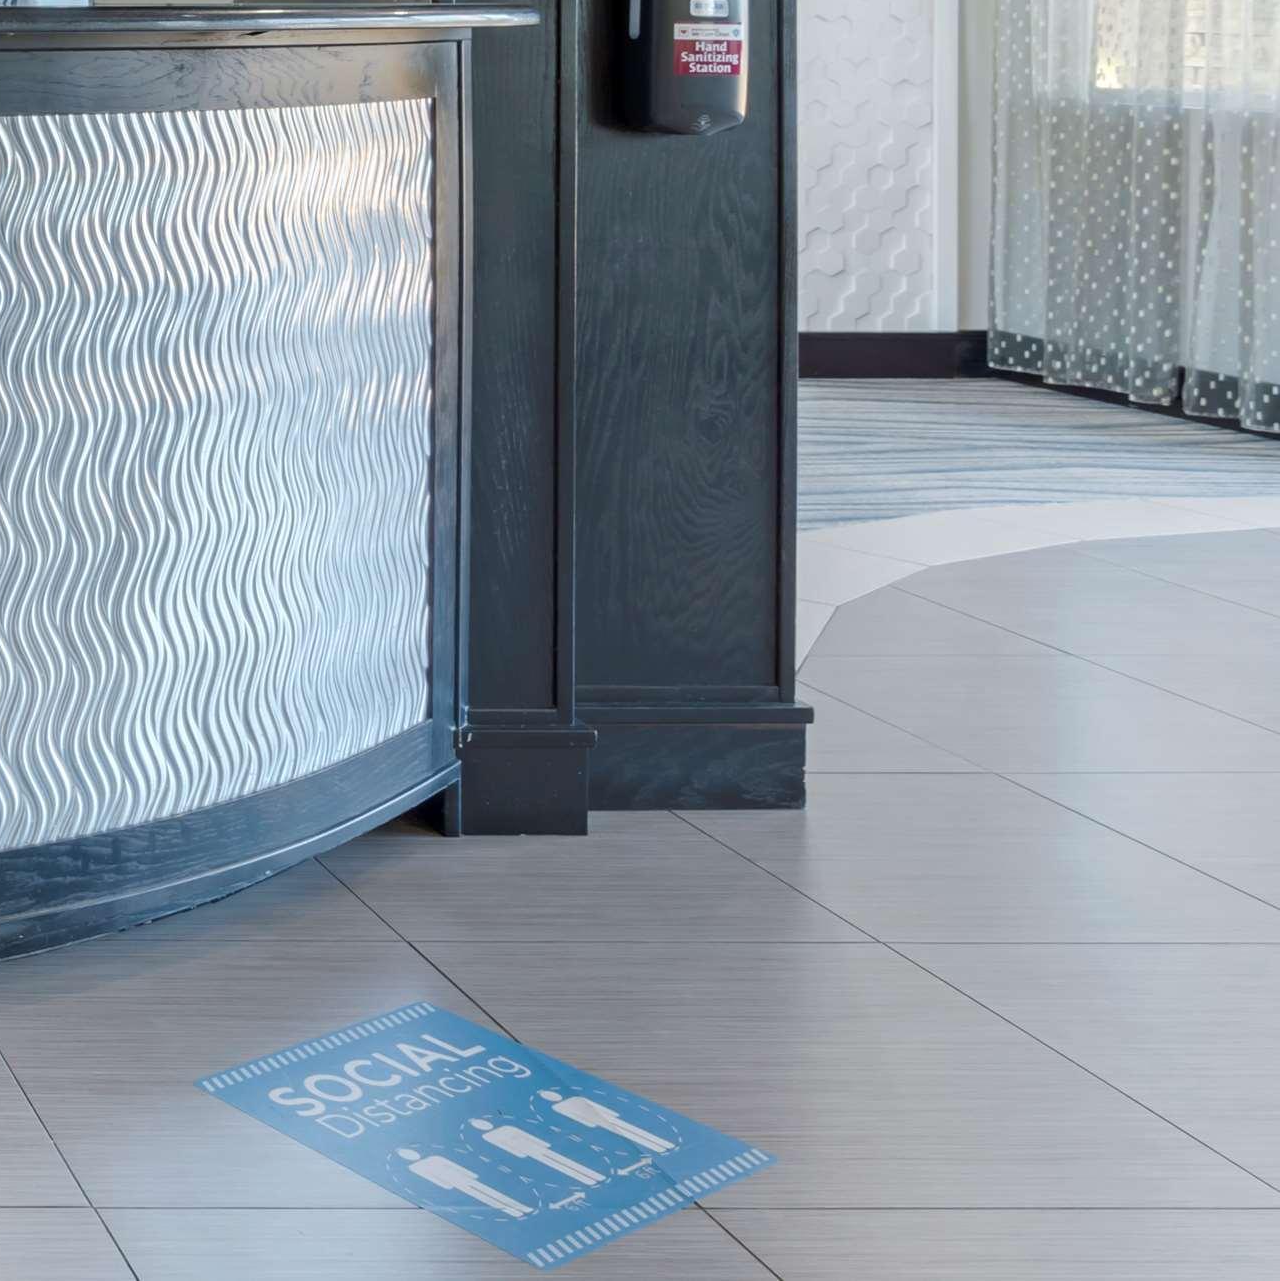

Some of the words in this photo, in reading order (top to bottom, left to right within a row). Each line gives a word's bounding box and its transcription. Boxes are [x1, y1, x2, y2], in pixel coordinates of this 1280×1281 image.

[695, 41, 728, 51] Hand
[681, 51, 739, 65] Sanitizing
[689, 62, 732, 73] Station
[268, 1034, 487, 1117] SOCIAL
[314, 1055, 533, 1138] Distancing
